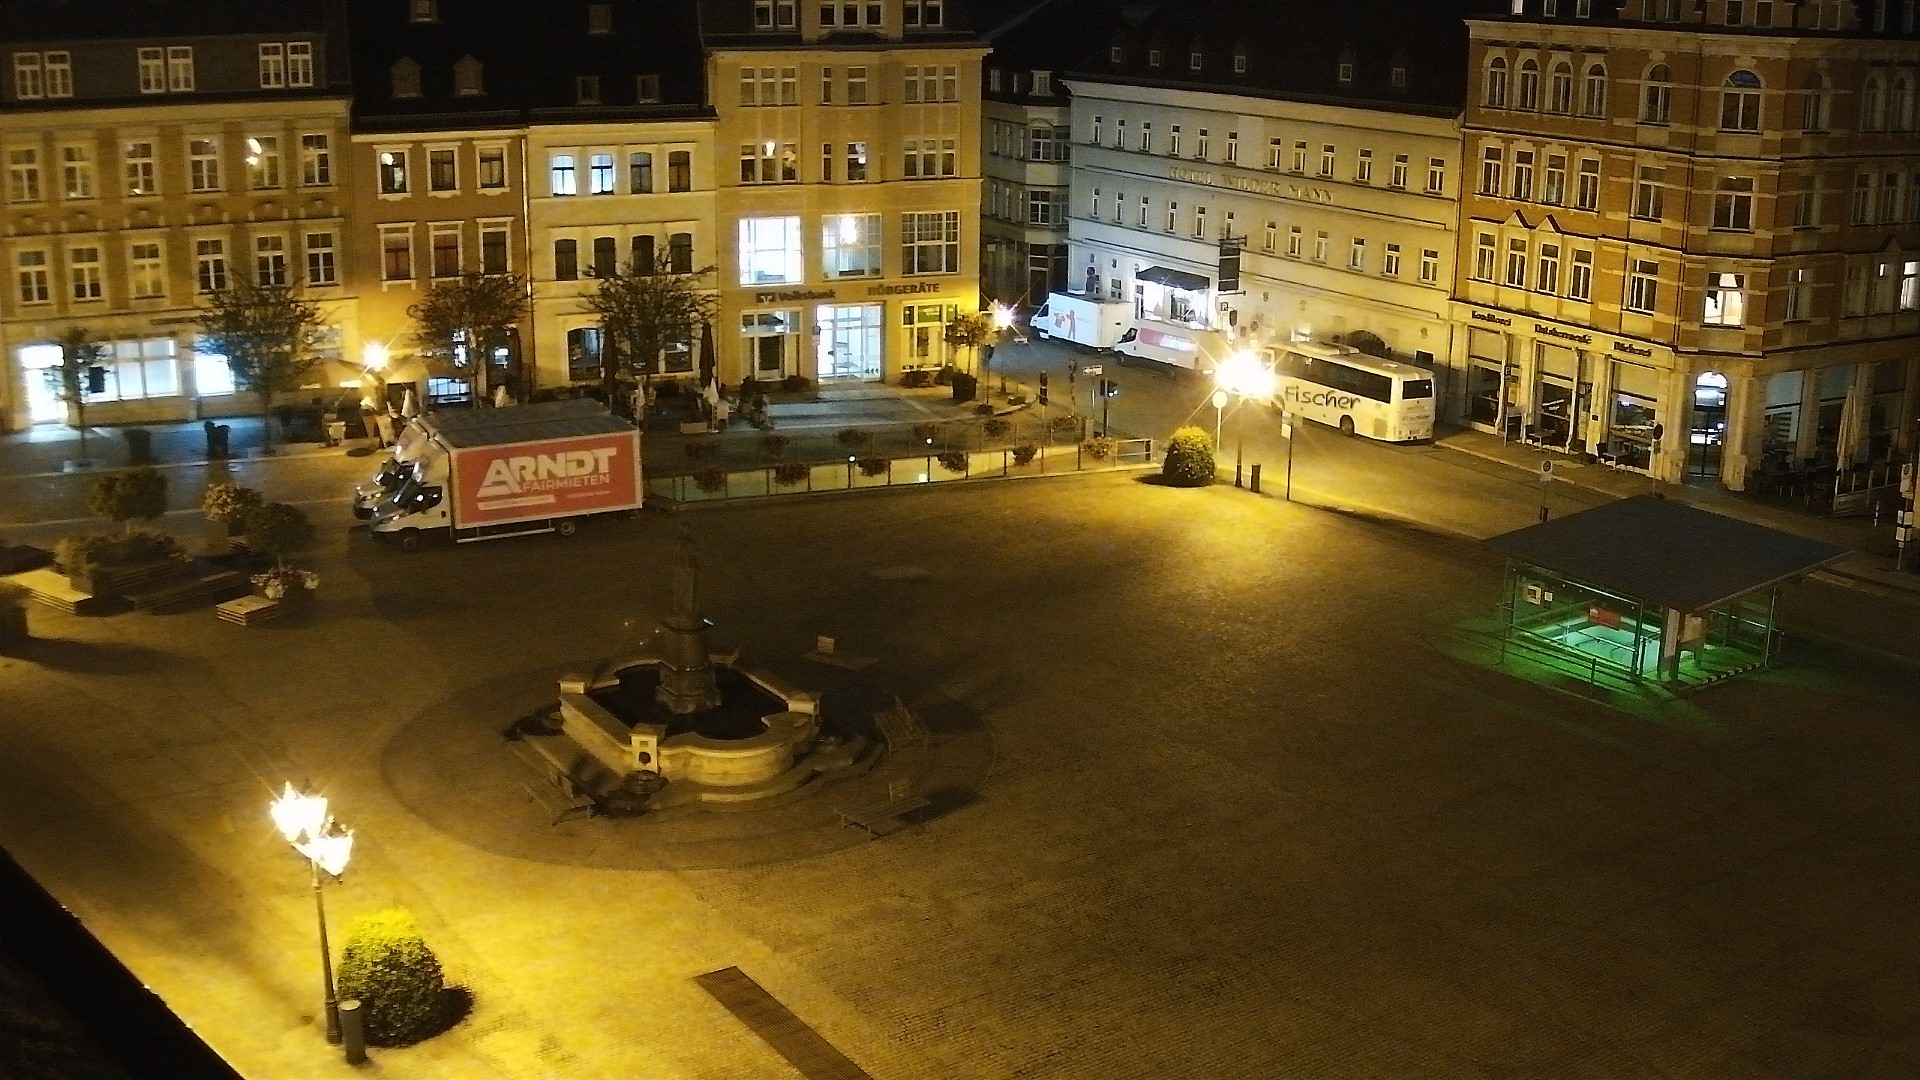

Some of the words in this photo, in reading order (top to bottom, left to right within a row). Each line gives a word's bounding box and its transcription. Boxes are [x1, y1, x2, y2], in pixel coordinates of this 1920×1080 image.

[1169, 166, 1213, 186] HOTEL
[1222, 173, 1280, 195] WILDER
[1289, 183, 1334, 203] MANN
[1285, 386, 1361, 410] Fischer
[476, 447, 617, 499] ARNDT
[523, 473, 610, 493] FAIRMIETEN
